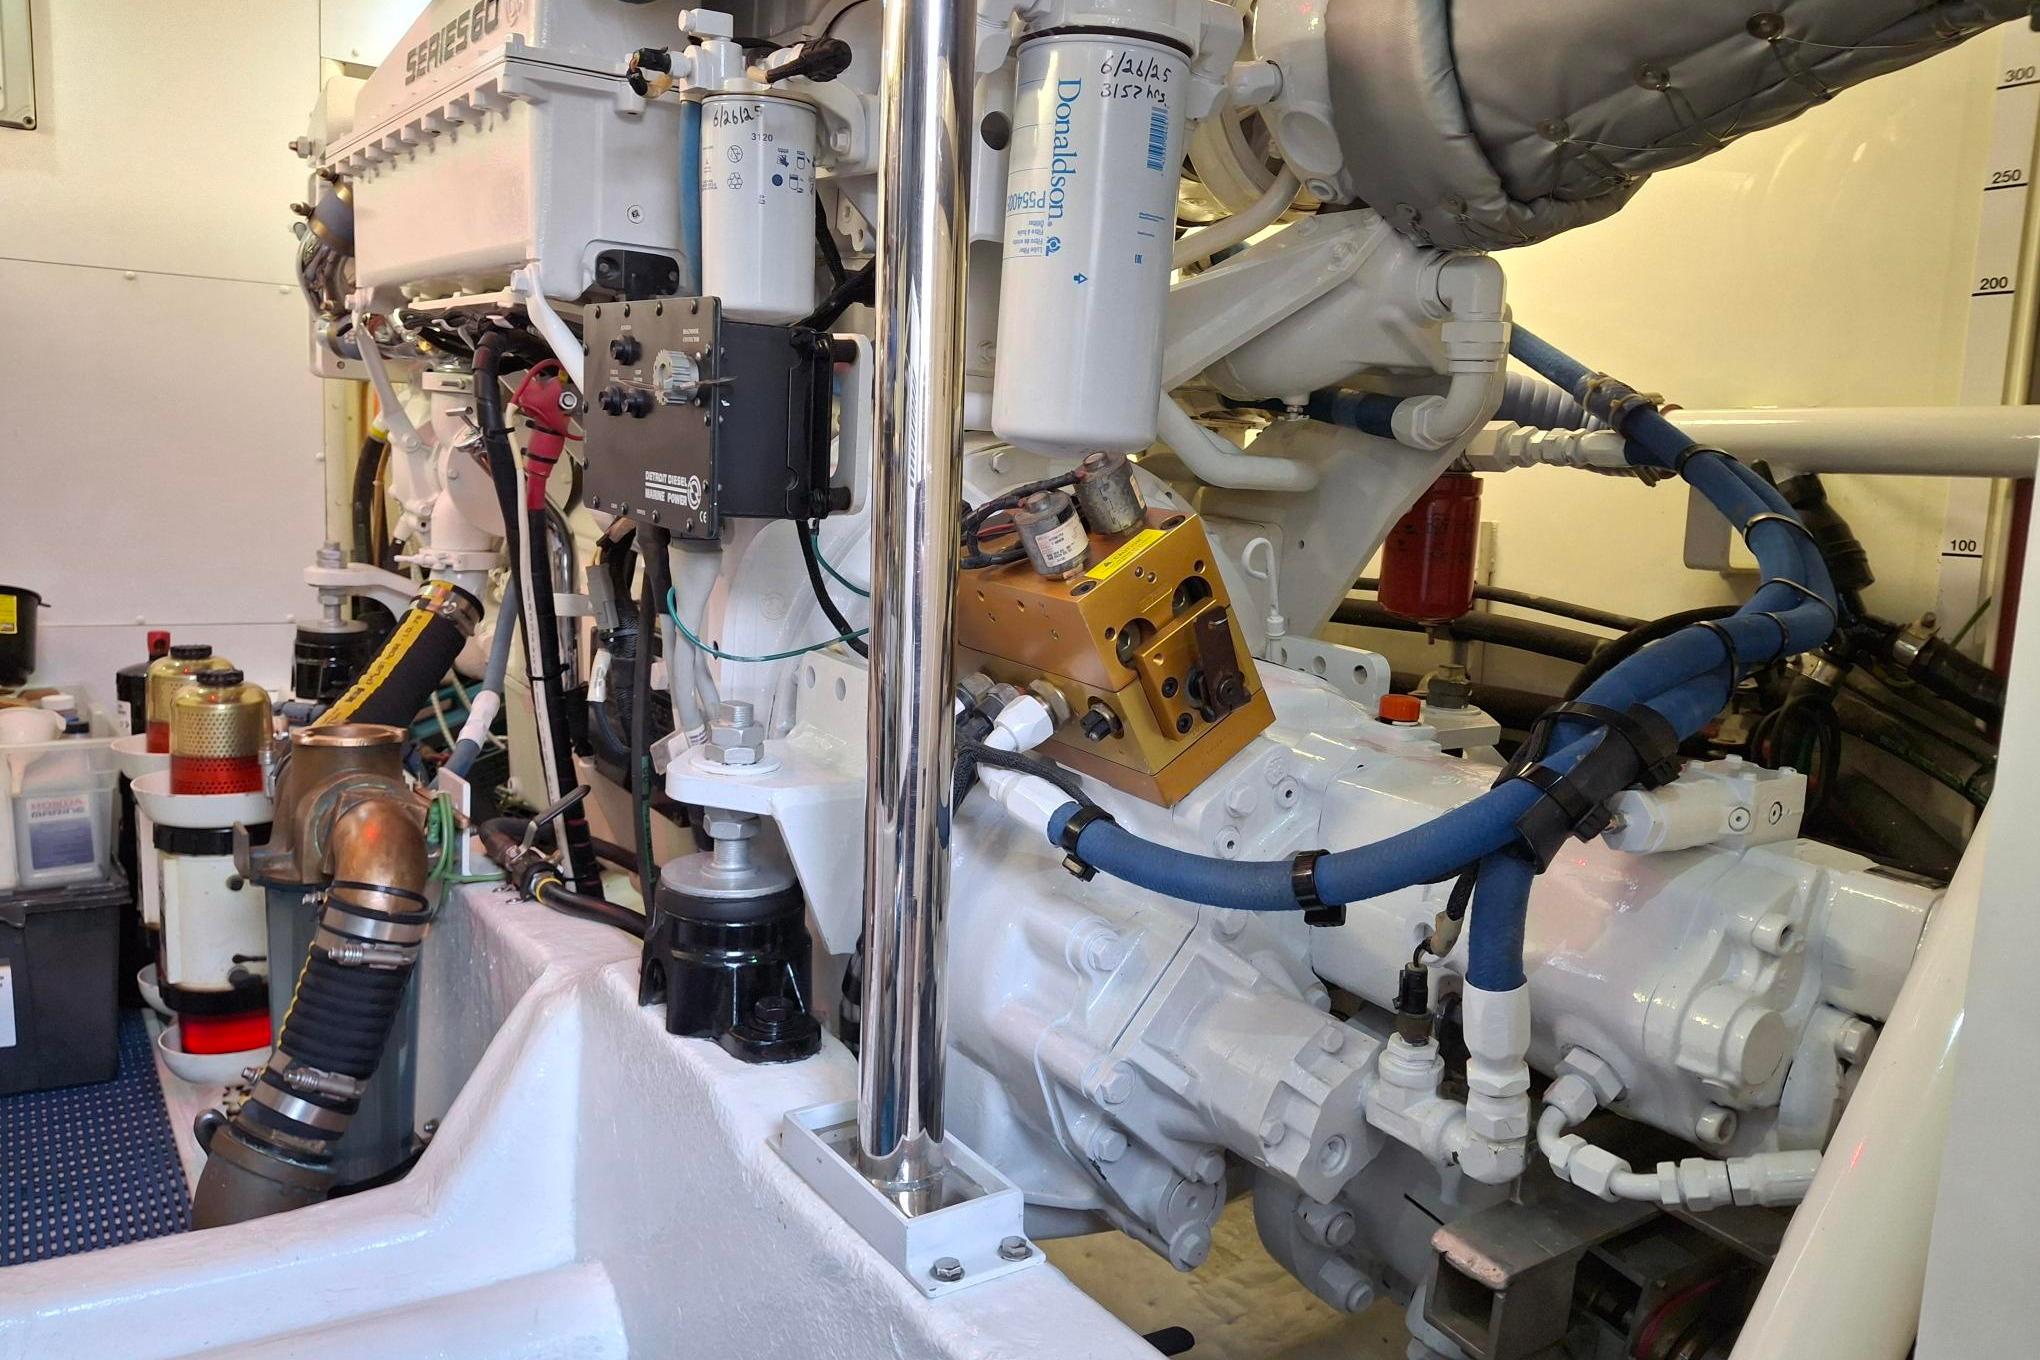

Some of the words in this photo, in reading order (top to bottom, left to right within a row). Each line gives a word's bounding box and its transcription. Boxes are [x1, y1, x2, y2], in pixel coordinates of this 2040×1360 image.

[1100, 51, 1171, 83] 6/26/25
[2005, 65, 2036, 82] 300
[751, 132, 774, 142] 3120
[1048, 77, 1082, 220] Donaldson
[1991, 169, 2022, 184] 250
[1979, 276, 2008, 290] 200
[645, 470, 668, 484] DETROIT
[667, 475, 688, 487] DIESEL
[644, 488, 666, 502] MARINE
[667, 493, 688, 506] POWER
[1950, 539, 1977, 552] 100
